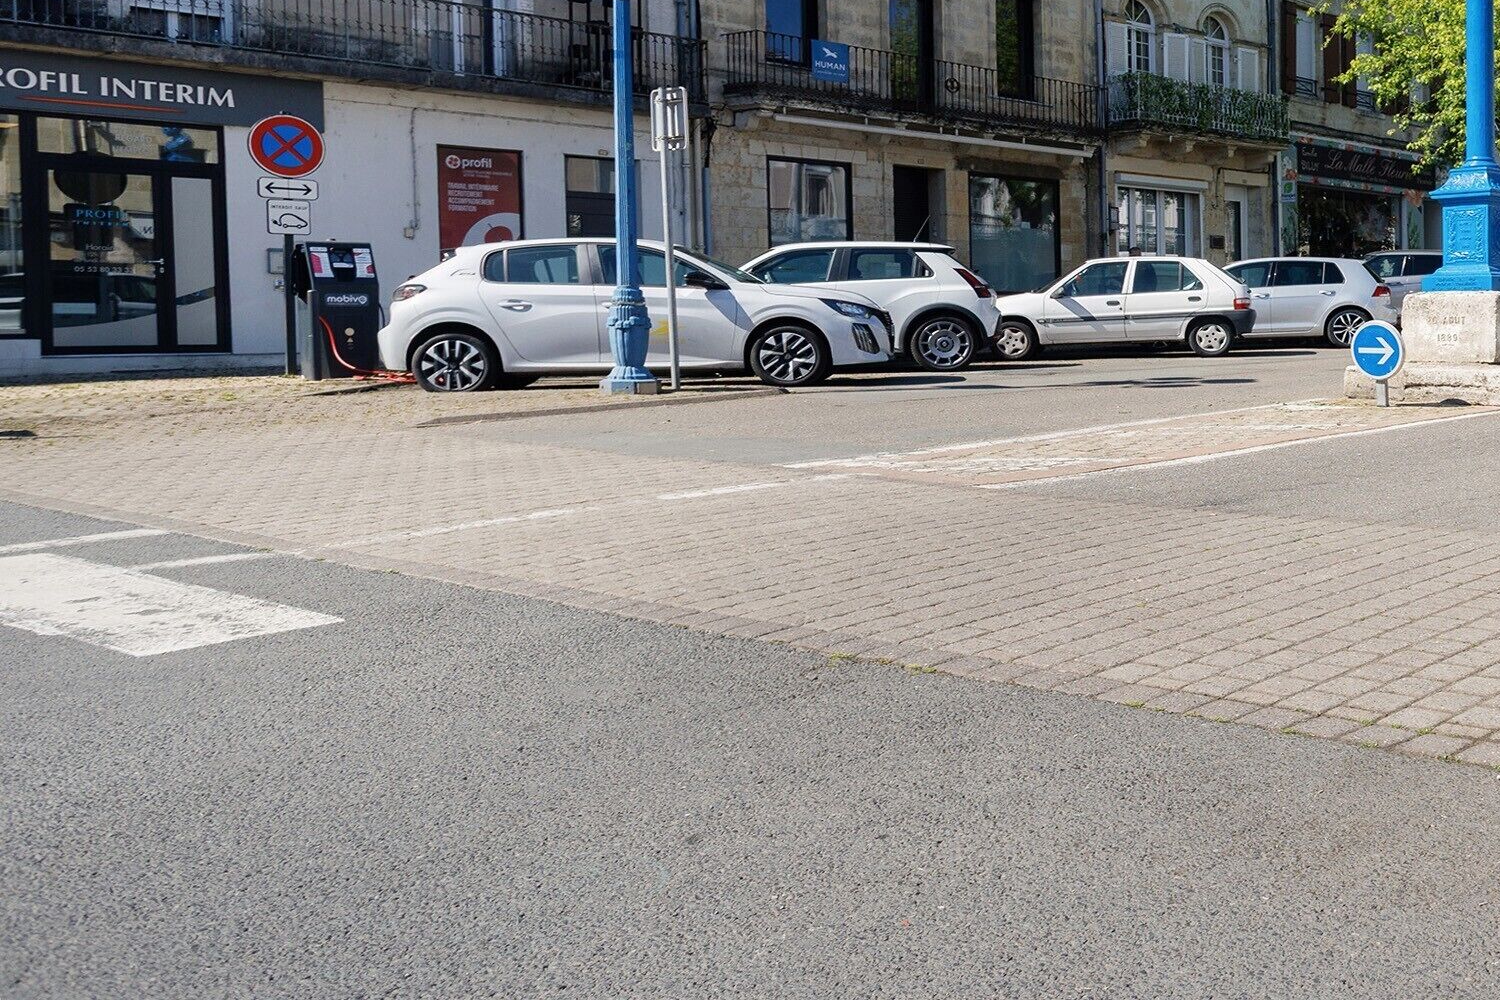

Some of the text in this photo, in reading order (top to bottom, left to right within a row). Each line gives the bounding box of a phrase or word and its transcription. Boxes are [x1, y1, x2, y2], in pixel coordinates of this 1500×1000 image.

[815, 60, 846, 71] HUMAN
[0, 67, 236, 108] OFIL INTERIM
[461, 157, 492, 169] profil
